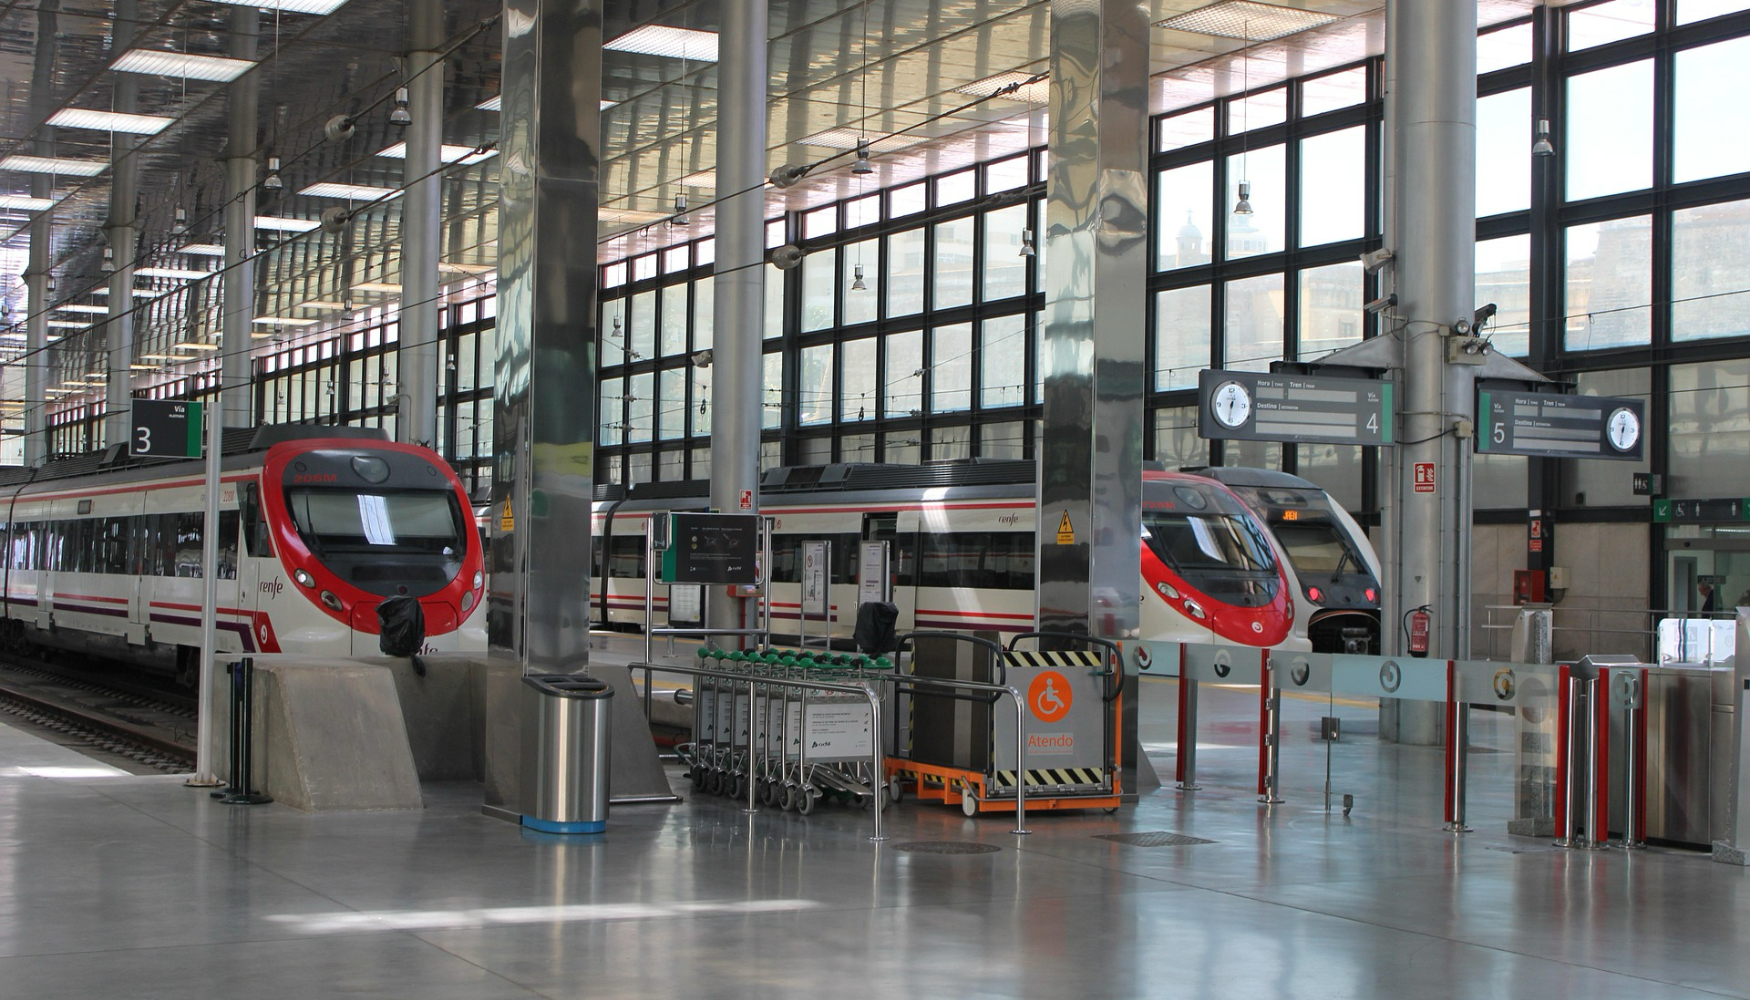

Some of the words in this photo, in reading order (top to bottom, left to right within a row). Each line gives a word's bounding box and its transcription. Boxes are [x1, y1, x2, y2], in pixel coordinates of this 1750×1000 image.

[174, 405, 185, 413] Vía
[1257, 402, 1278, 410] Destino
[1366, 412, 1379, 434] 4
[136, 426, 151, 453] 3
[1493, 422, 1505, 444] 5
[998, 512, 1019, 527] renfe
[260, 575, 284, 600] renfe
[1027, 733, 1074, 747] Atendo
